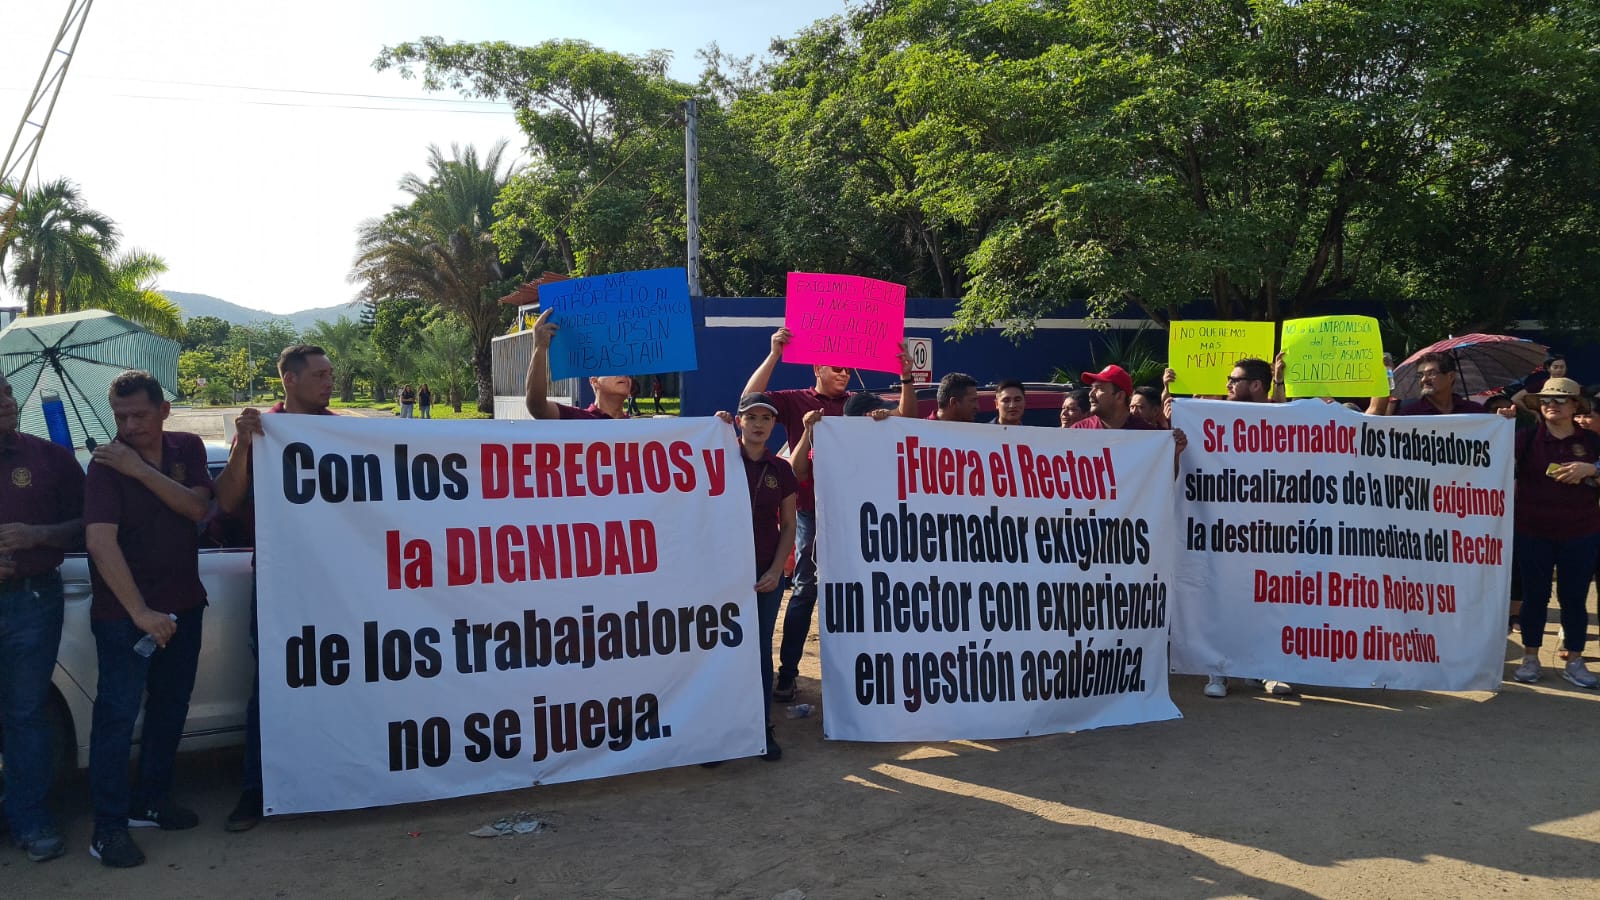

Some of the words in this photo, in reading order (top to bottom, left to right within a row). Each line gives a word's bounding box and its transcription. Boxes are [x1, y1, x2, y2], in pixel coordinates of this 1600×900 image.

[574, 279, 591, 294] NO
[915, 347, 925, 365] 10
[1310, 336, 1324, 346] del
[1331, 335, 1361, 347] Rector
[1321, 351, 1335, 360] los
[1291, 362, 1373, 382] SINDICALES
[896, 435, 986, 501] ¡Fuera
[988, 443, 1018, 499] el
[1016, 443, 1117, 501] Rector!
[1202, 418, 1229, 454] Sr.
[1232, 418, 1358, 458] Gobernador,
[1360, 421, 1386, 458] los
[1389, 427, 1491, 469] trabajadores
[282, 441, 383, 504] Con
[394, 443, 469, 501] los
[480, 440, 697, 500] DERECHOS
[702, 447, 726, 497] y
[1184, 467, 1338, 505] sindicalizados
[1342, 470, 1366, 506] de
[1367, 472, 1383, 508] la
[1384, 474, 1431, 512] UPSIN
[1432, 480, 1506, 519] exigimos
[386, 529, 433, 590] la
[445, 518, 659, 587] DIGNIDAD
[859, 501, 1029, 564] Gobernador
[1034, 507, 1150, 572] exigimos
[1186, 516, 1207, 553] la
[1210, 517, 1333, 556] destitución
[1338, 520, 1422, 562] inmediata
[1424, 528, 1449, 563] del
[1451, 529, 1504, 566] Rector
[824, 580, 865, 633] un
[871, 571, 973, 633] Rector
[978, 580, 1032, 633] con
[1036, 572, 1167, 638] experiencia
[1253, 568, 1323, 606] Daniel
[1327, 570, 1380, 609] Brito
[1382, 573, 1425, 615] Rojas
[1426, 583, 1436, 616] y
[1437, 583, 1457, 614] su
[285, 625, 350, 689] de
[363, 620, 443, 683] los
[452, 600, 744, 675] trabajadores
[1281, 622, 1358, 663] equipo
[1362, 624, 1441, 664] directivo.
[854, 652, 896, 706] en
[902, 638, 1016, 713] gestión
[1019, 637, 1146, 701] académica.
[388, 715, 452, 772] no
[463, 705, 521, 763] se
[532, 692, 672, 762] juega.
